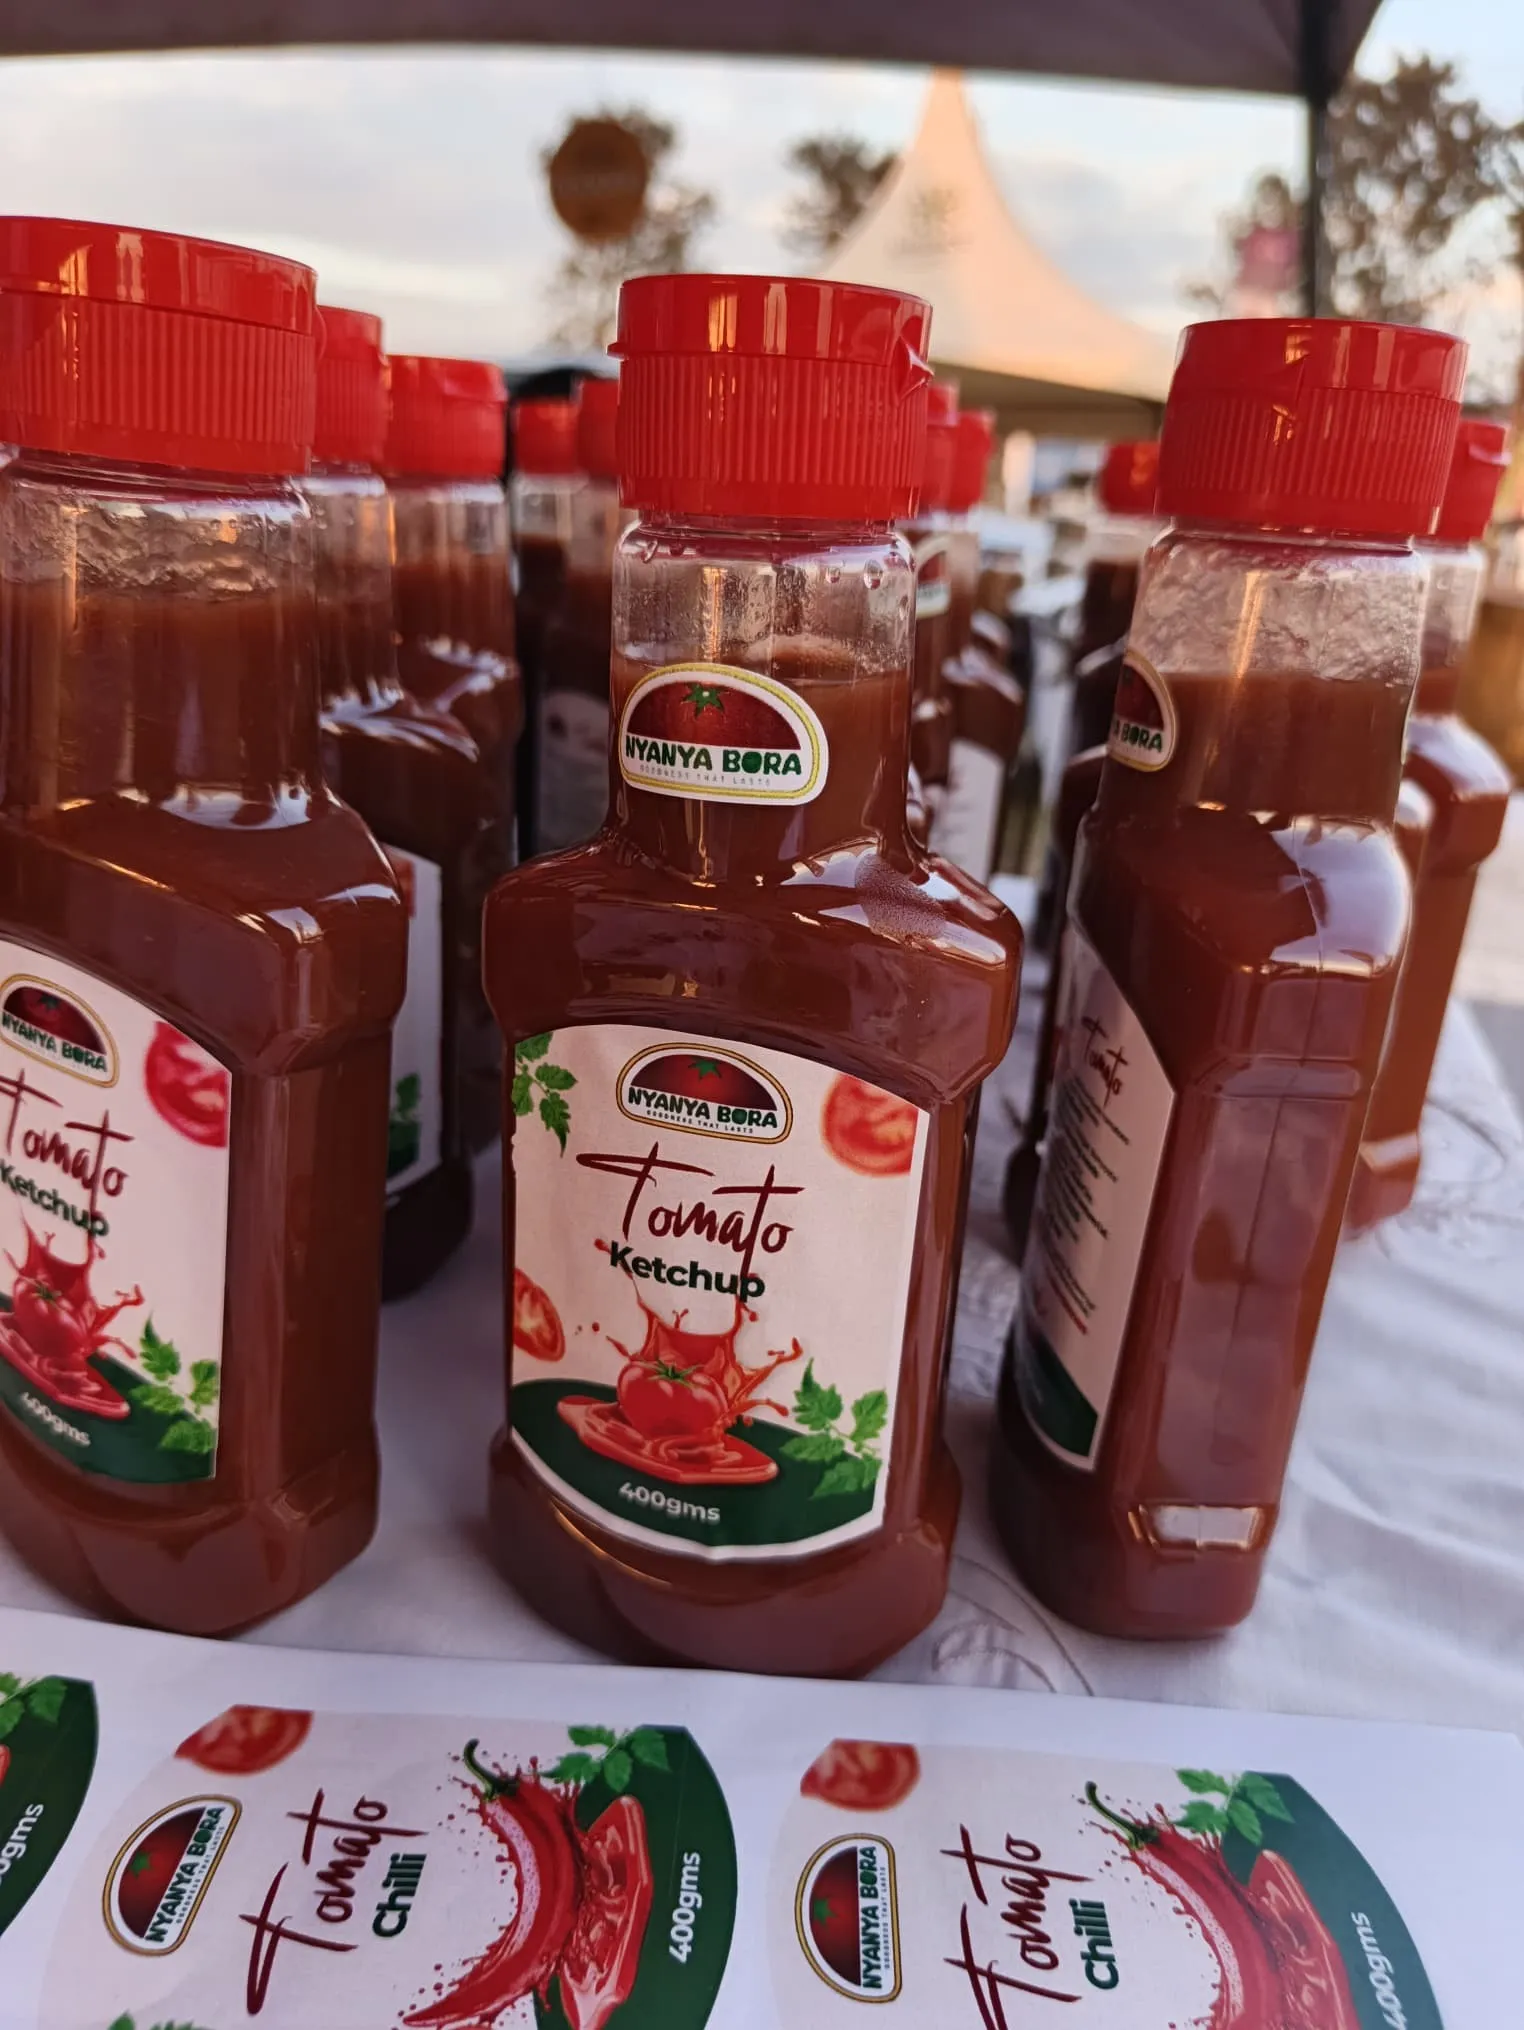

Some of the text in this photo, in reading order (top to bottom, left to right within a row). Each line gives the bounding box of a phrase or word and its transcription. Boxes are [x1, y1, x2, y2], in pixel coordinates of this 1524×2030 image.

[625, 734, 802, 775] NYANYA BORA
[1121, 723, 1162, 753] BORA
[2, 1011, 57, 1053] NYANYA
[62, 1040, 107, 1073] BORA
[0, 1068, 135, 1212] Tomato
[628, 1086, 778, 1128] NYANYA BORA
[698, 1119, 719, 1130] THAT
[0, 1158, 109, 1238] Ketchup
[576, 1141, 805, 1277] Tomato
[610, 1241, 765, 1301] Ketchup
[619, 1481, 720, 1523] 400gms
[145, 1808, 226, 1942] NYANYA BORA
[239, 1788, 429, 2016] Tomato
[372, 1853, 427, 1938] Chilli
[669, 1852, 702, 1963] 400gms
[859, 1846, 882, 1989] NYANYA BORA
[940, 1823, 1095, 2030] Tomato
[1069, 1898, 1119, 1989] Chilli
[1351, 1912, 1407, 2030] 400gms
